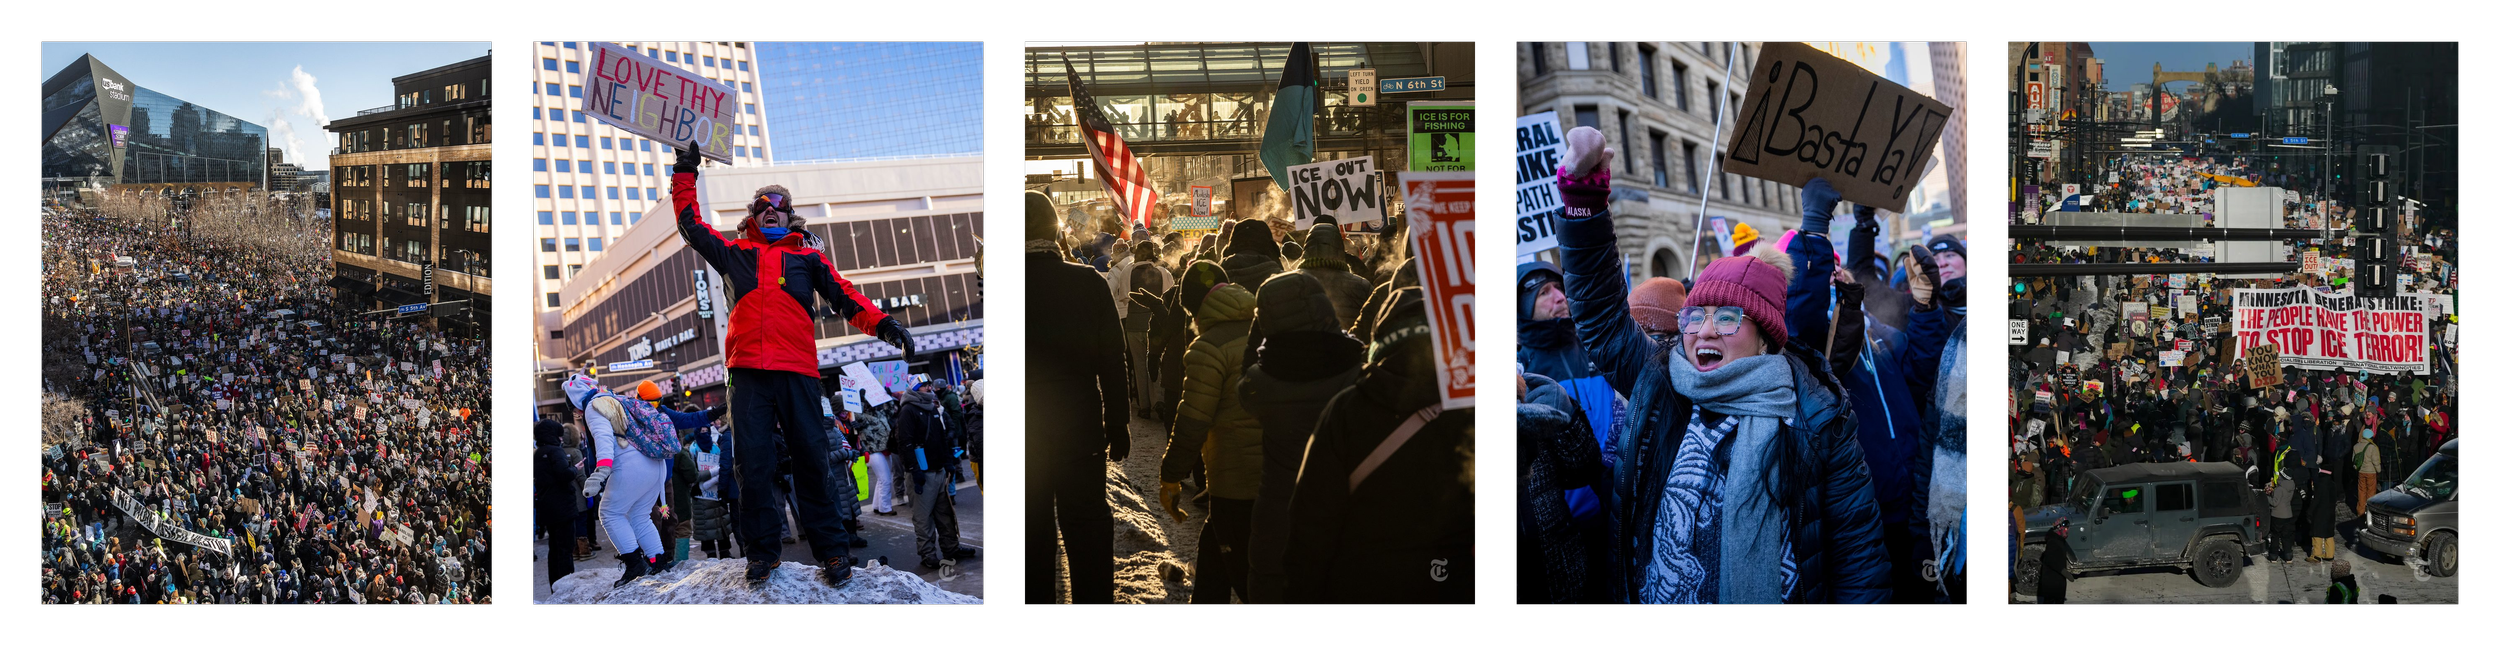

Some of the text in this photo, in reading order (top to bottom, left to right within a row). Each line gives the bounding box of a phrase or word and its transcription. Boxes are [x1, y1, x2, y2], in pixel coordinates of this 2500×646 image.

[597, 48, 725, 119] LOVE THY
[1408, 80, 1426, 89] 6th
[1431, 80, 1442, 88] St
[109, 91, 130, 101] stadium
[591, 76, 729, 155] NEIGHBOR
[1871, 94, 1947, 199] Ya!
[1292, 159, 1367, 185] ICE OUT
[1193, 190, 1210, 198] Abolish
[1294, 174, 1375, 220] NOW
[1196, 199, 1206, 207] ICE
[1433, 201, 1471, 214] WE KEEP
[1194, 207, 1209, 215] Now!
[1568, 206, 1591, 216] ALASKA
[1272, 220, 1295, 231] ICE
[424, 264, 432, 295] EDITION
[890, 295, 920, 308] BAR
[2239, 290, 2308, 307] MINNESOTA
[2368, 296, 2422, 311] STRIKE:
[2238, 306, 2423, 333] THE PEOPLE HAVE THE POWER
[628, 336, 652, 361] TOM'S
[679, 328, 694, 342] BAR
[2238, 327, 2423, 362] TO STOP ICE TERROR!
[2248, 344, 2272, 356] YOU
[2248, 352, 2278, 365] KNOW
[873, 362, 899, 374] CHILD
[2250, 362, 2277, 372] WHAT
[2254, 369, 2275, 378] YOU
[841, 377, 855, 388] STOP
[2255, 376, 2277, 387] DID
[699, 454, 717, 463] LIFE
